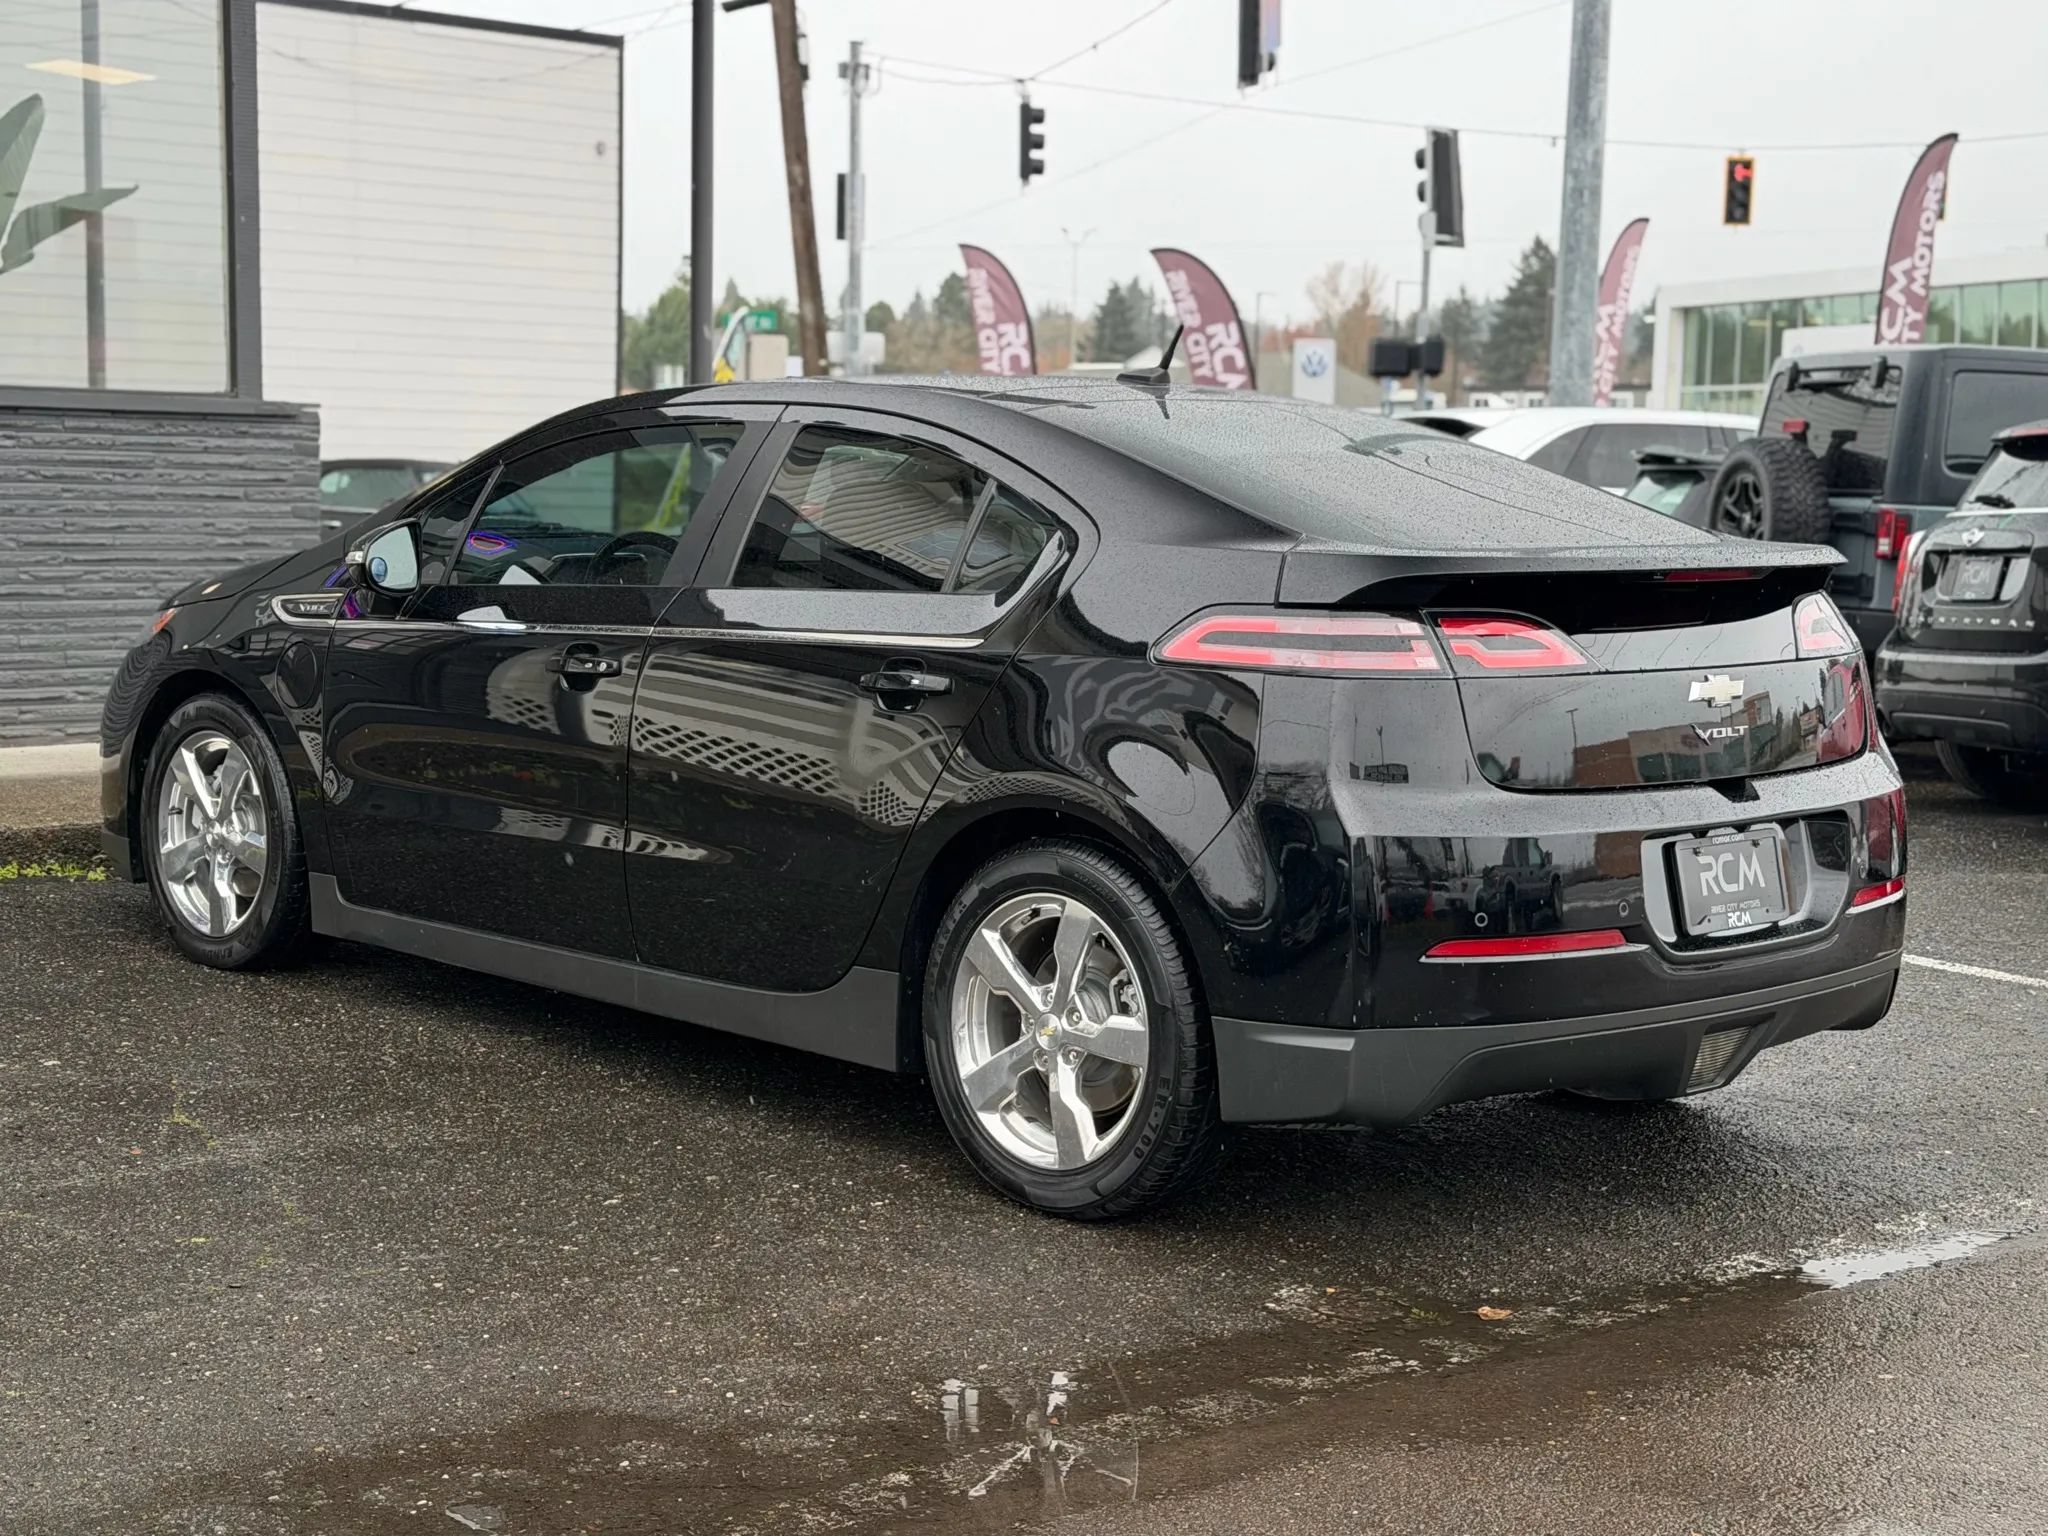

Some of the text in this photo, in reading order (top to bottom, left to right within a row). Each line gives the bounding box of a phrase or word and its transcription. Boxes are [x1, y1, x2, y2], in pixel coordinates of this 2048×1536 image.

[1901, 170, 1944, 344] TY MOTORS
[1879, 256, 1913, 343] CM
[1165, 269, 1214, 378] RIVER CITY
[978, 328, 1001, 373] CITY
[997, 322, 1031, 375] RC
[1690, 724, 1749, 746] VOLT
[1696, 850, 1766, 896] RCM
[1710, 899, 1761, 914] RIVER CITY MOTORS
[1727, 911, 1752, 928] RCM
